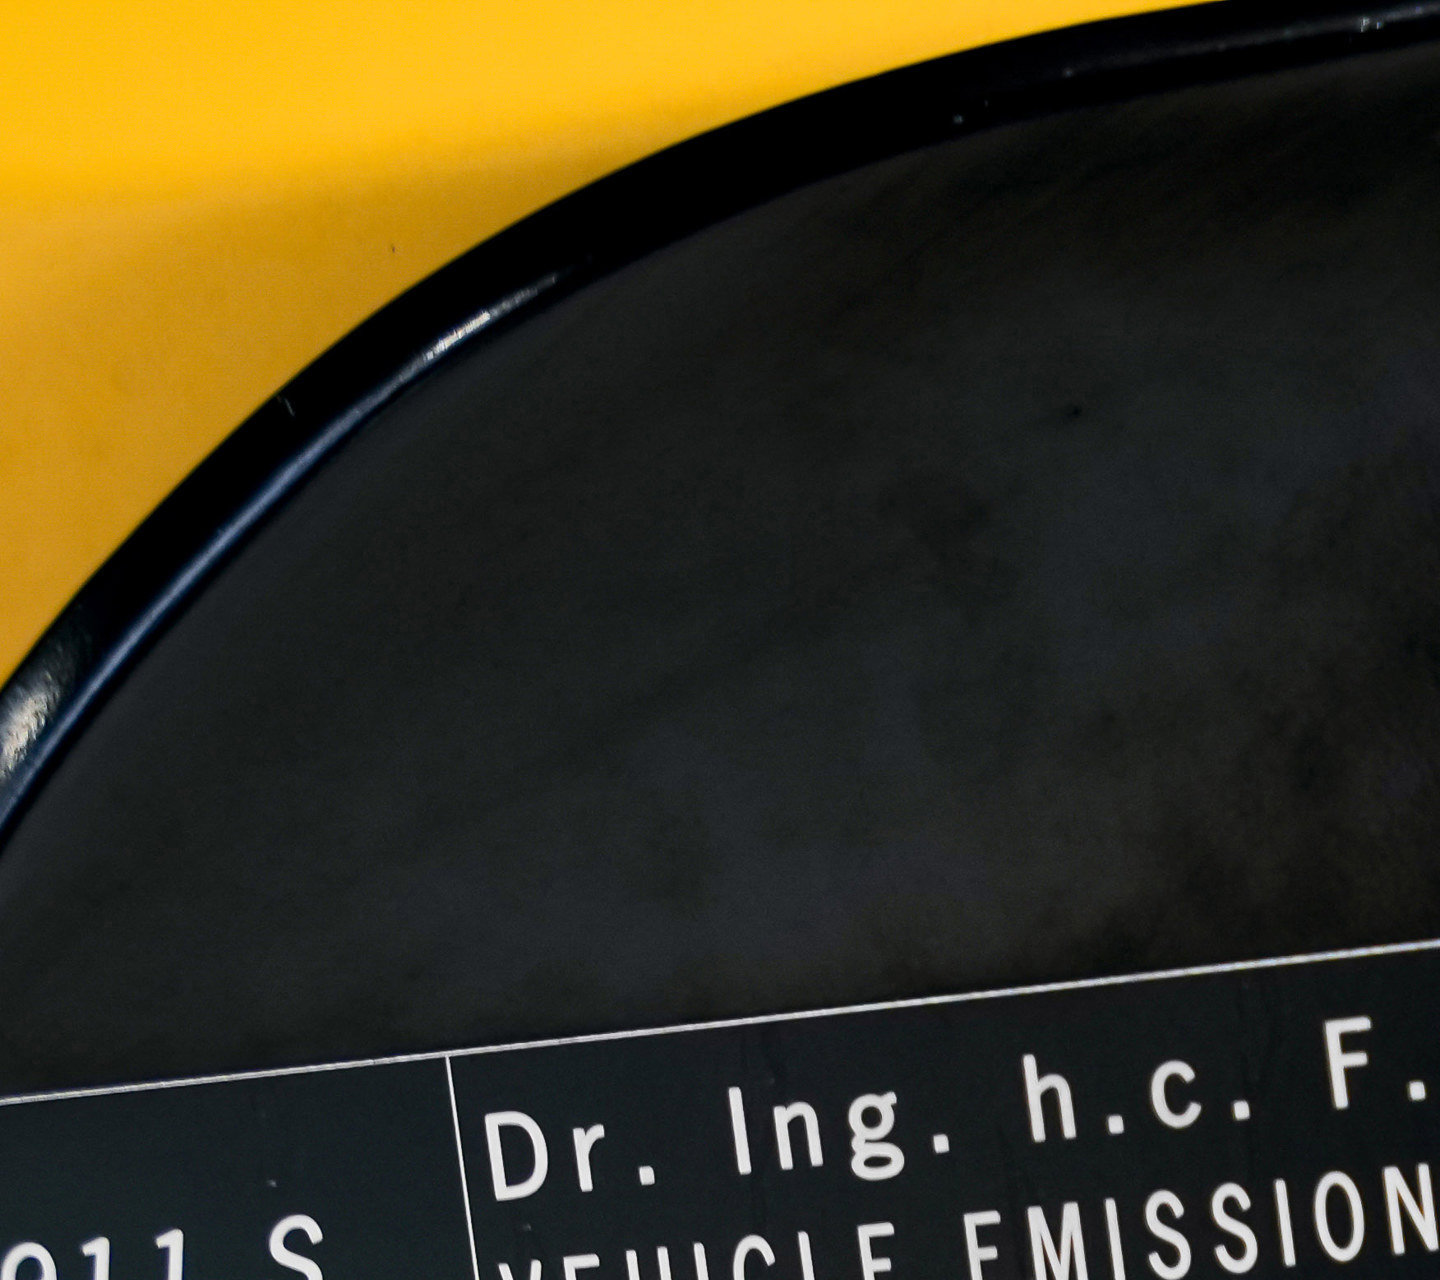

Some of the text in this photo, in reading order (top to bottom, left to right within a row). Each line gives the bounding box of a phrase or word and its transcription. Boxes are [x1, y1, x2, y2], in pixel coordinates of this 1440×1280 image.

[482, 1108, 658, 1204] Dr.
[726, 1084, 952, 1183] Ing.
[1020, 1051, 1252, 1145] h.c.
[1322, 1014, 1428, 1112] F.
